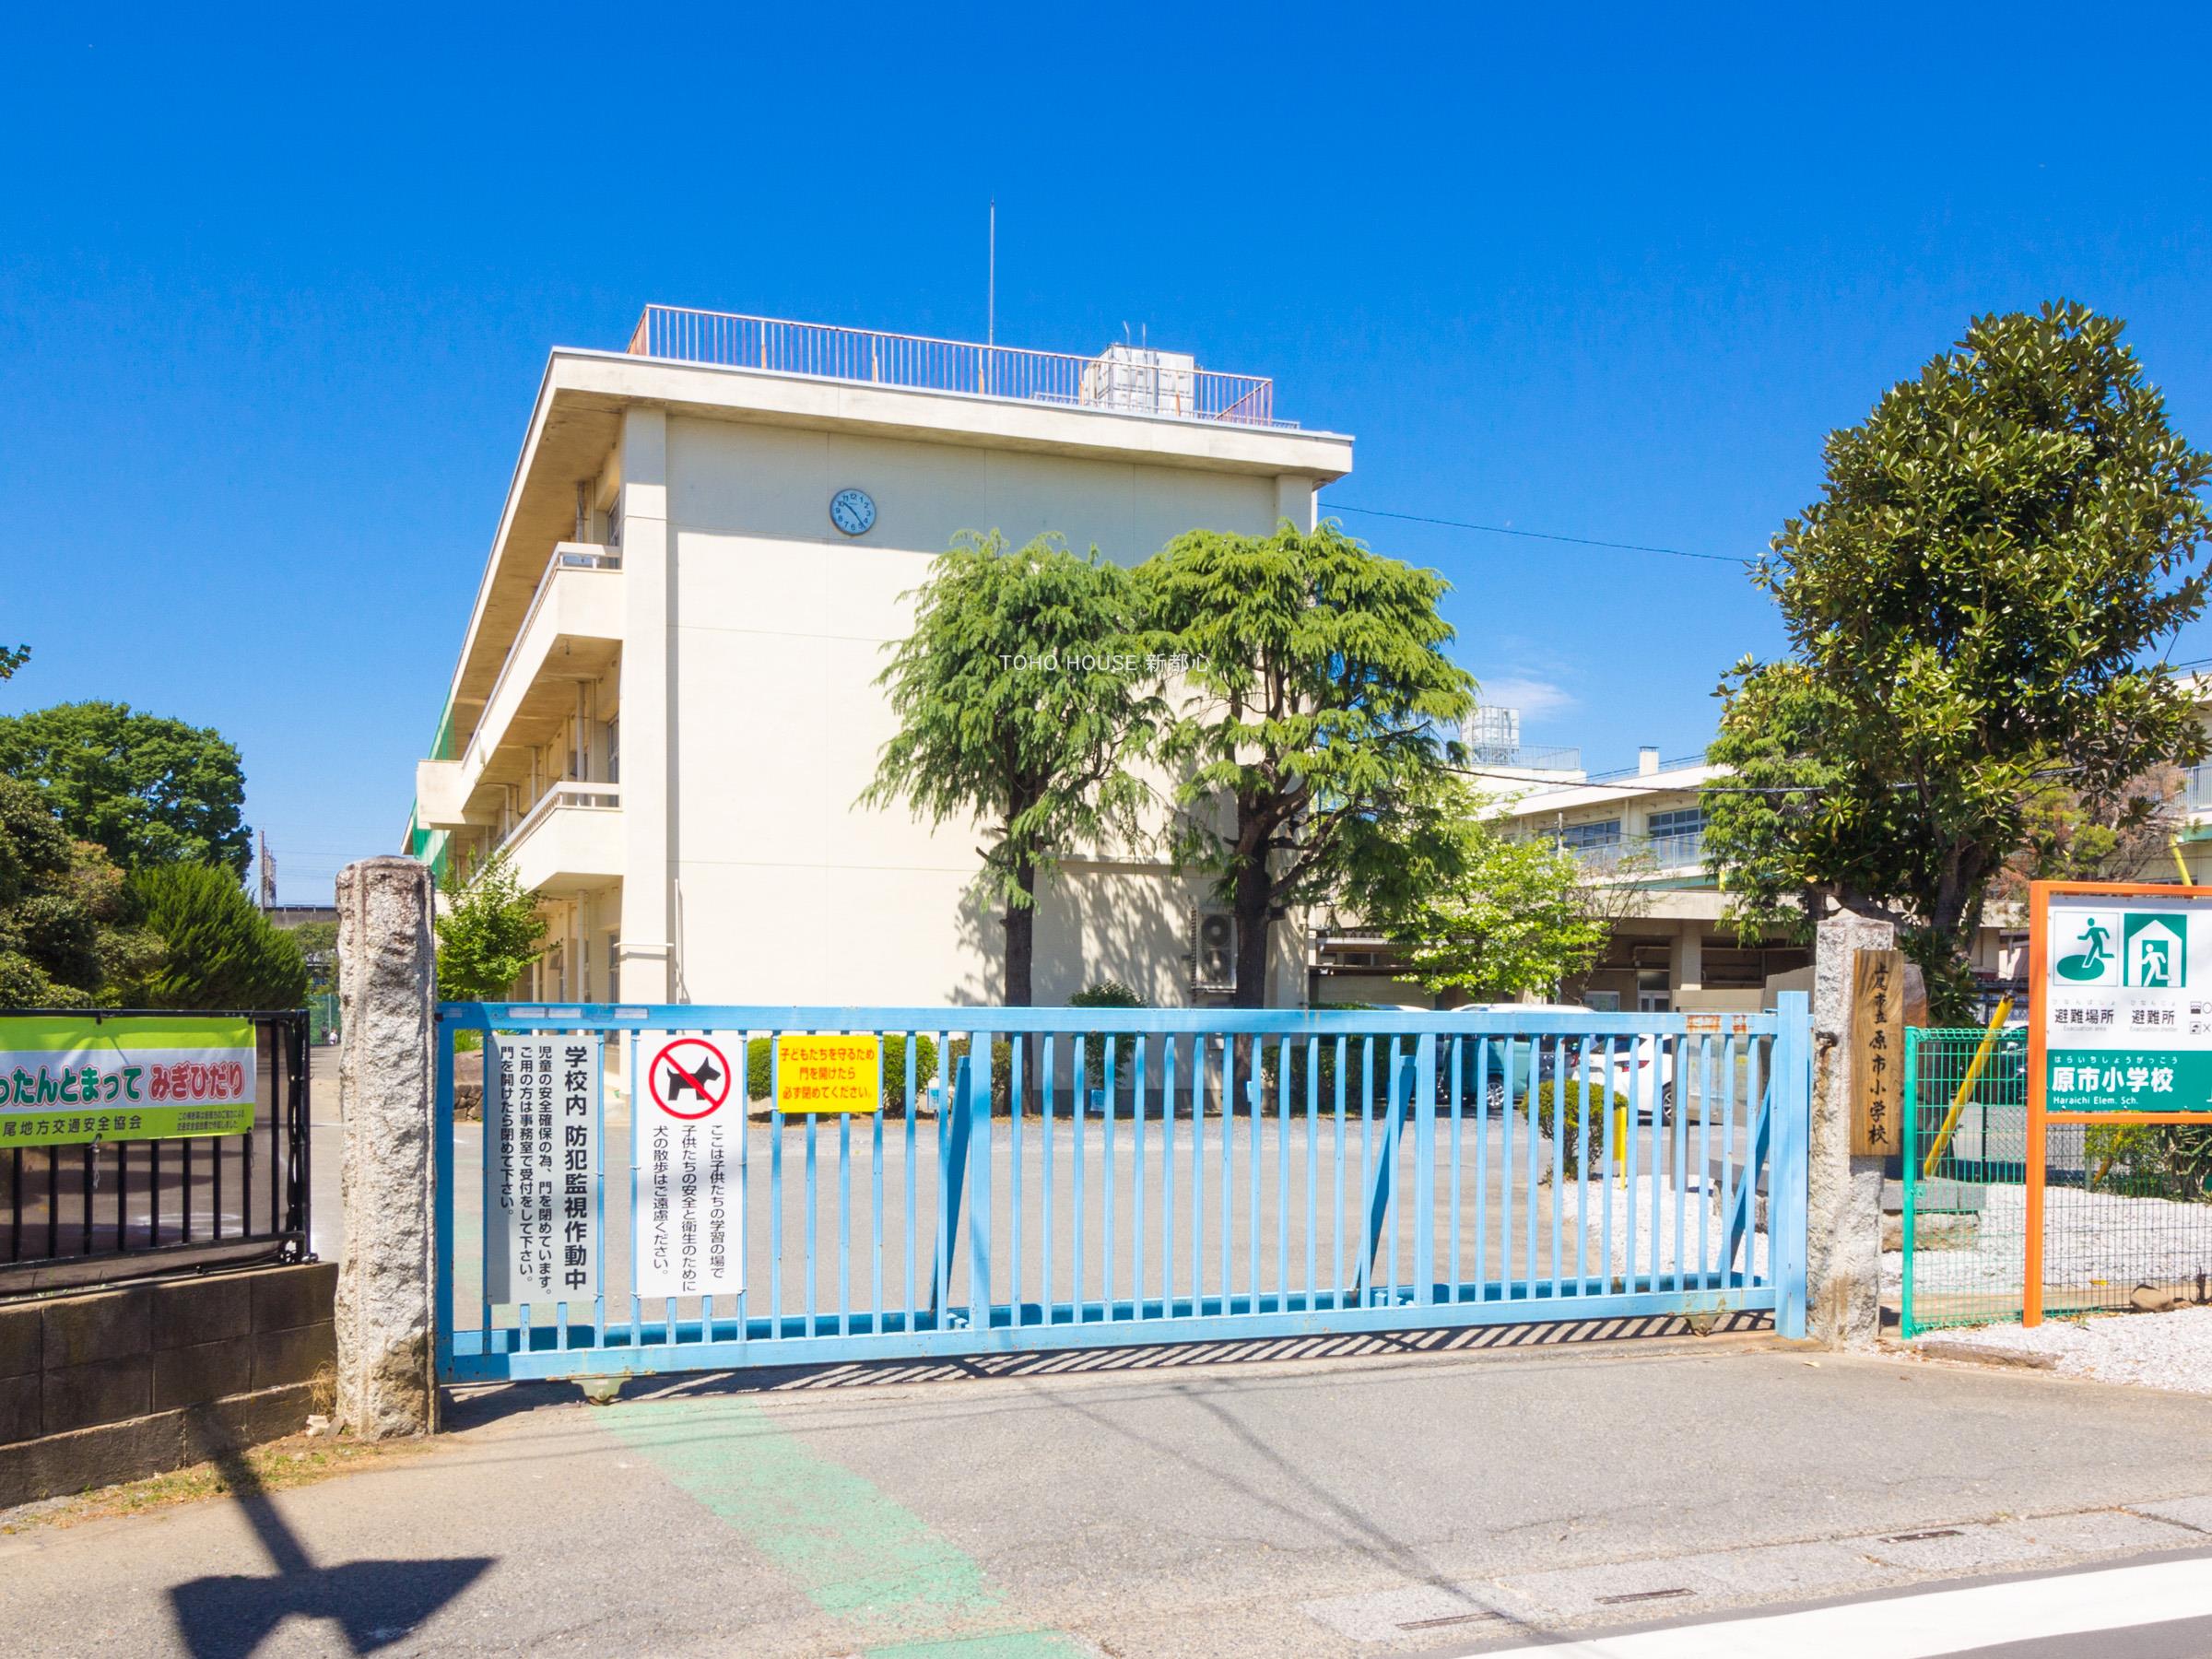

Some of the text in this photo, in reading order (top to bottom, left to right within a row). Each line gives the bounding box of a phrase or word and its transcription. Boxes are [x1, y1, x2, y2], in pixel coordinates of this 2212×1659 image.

[2054, 1008, 2114, 1025] 避難場所
[2131, 1009, 2175, 1025] 避難所
[781, 1047, 875, 1062] 子どもたちを守るため
[2054, 1055, 2178, 1064] はらいちしょうがっこう
[150, 1061, 244, 1100] みぎひだり
[799, 1066, 856, 1080] 門を開けたら
[2052, 1065, 2174, 1093] 原市小学校
[782, 1086, 872, 1100] 必ず閉めてください。
[2053, 1096, 2138, 1105] Haraichi Elem. Sch.
[3, 1115, 142, 1137] 尾地方交通安全協会
[500, 1046, 514, 1216] 門を開けたら閉めて下さい。
[519, 1046, 533, 1282] ご用の方は事務室で受付をして下さい。
[564, 1046, 588, 1290] 学校内 防犯監視作動中
[653, 1124, 669, 1275] 犬の散歩はご遠慮ください。
[681, 1124, 697, 1292] 子供たちの安全と衛生のために
[710, 1124, 725, 1279] ここは子供たちの学習の場で
